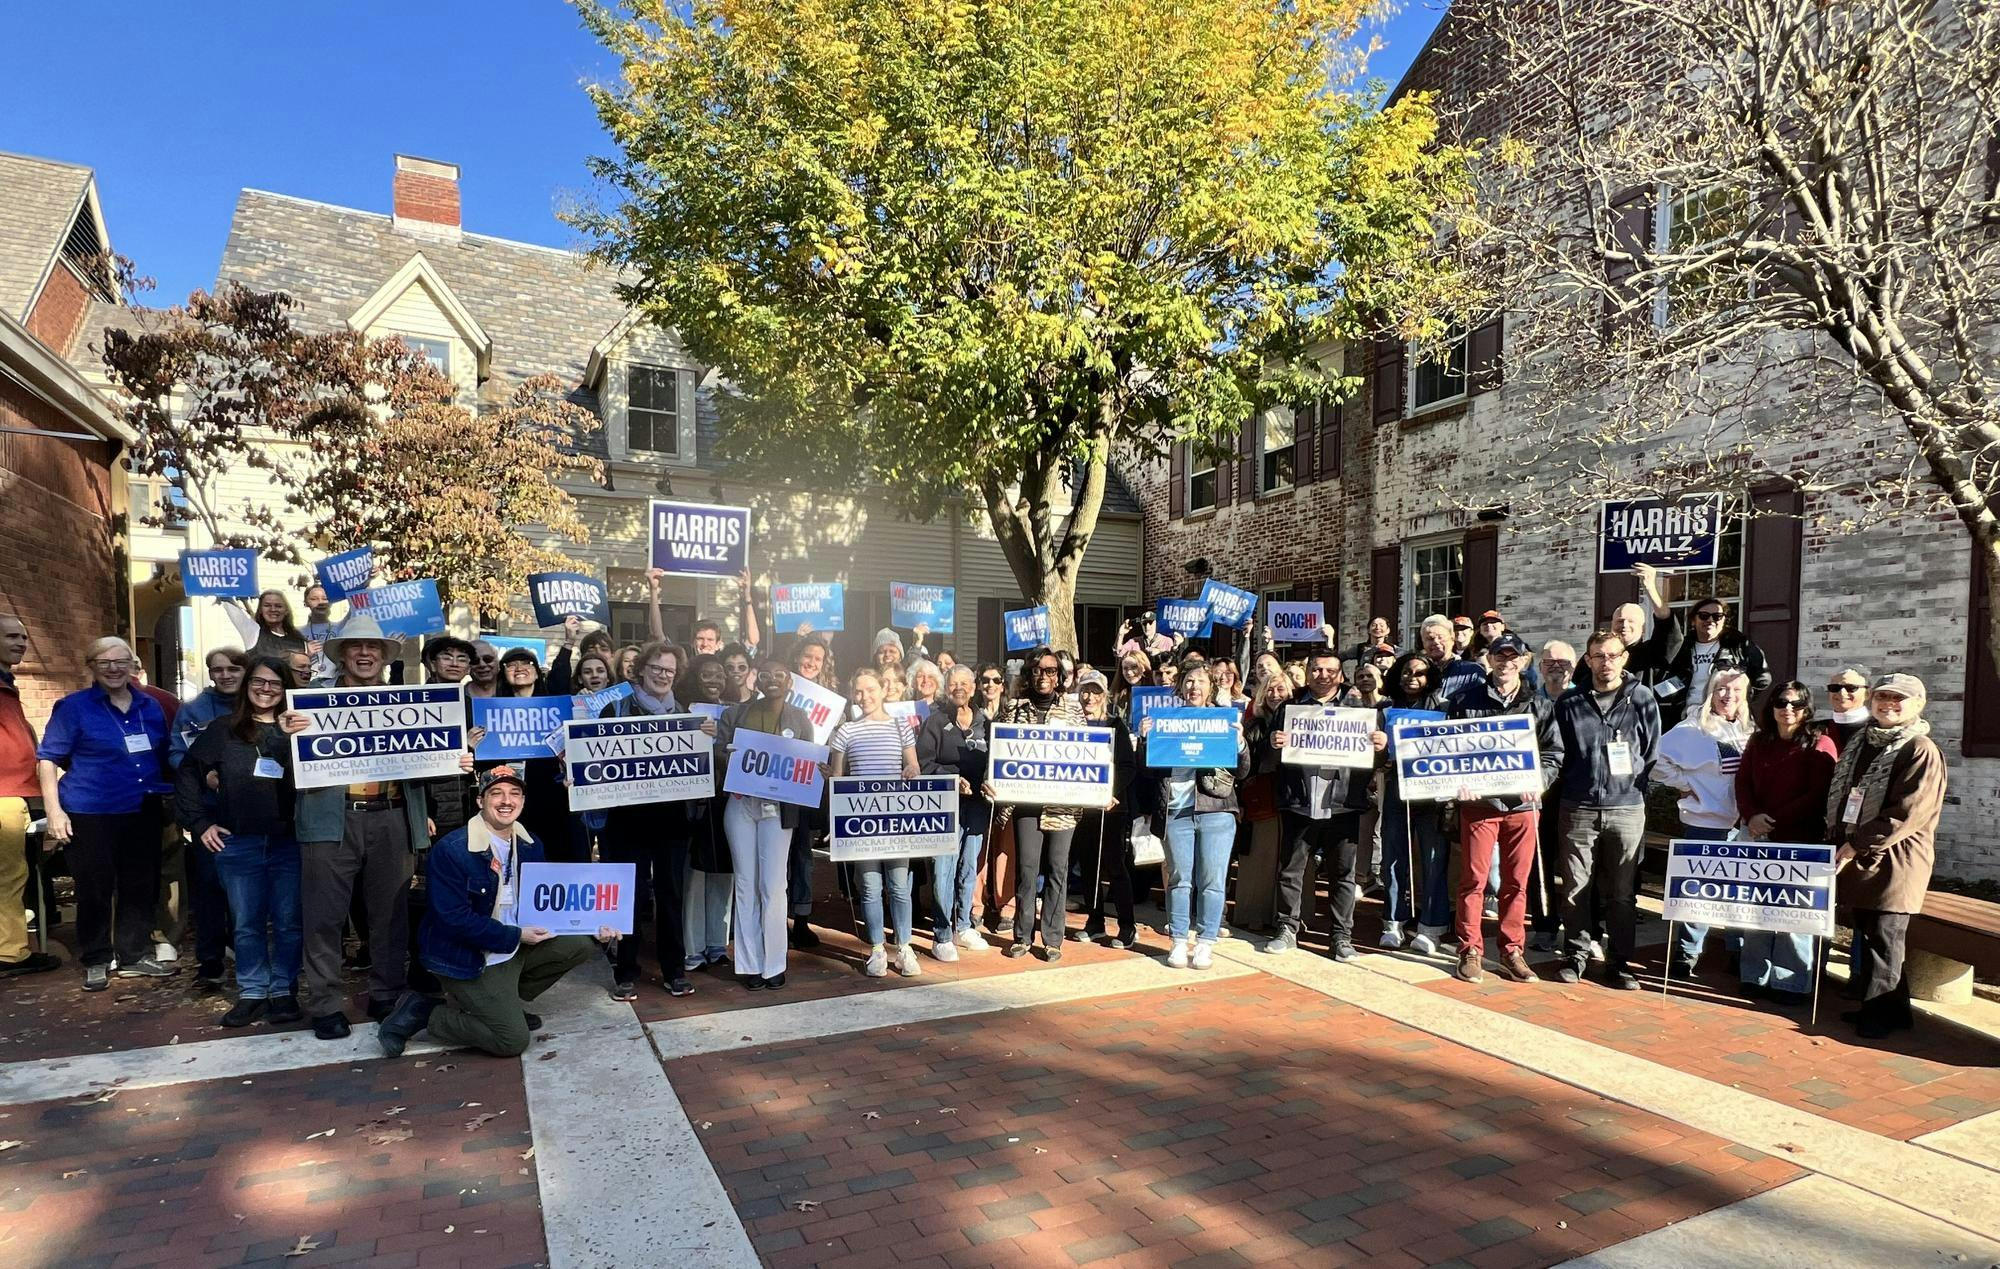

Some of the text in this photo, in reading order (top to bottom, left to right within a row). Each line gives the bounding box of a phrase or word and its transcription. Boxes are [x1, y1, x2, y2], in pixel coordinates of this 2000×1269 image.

[659, 512, 740, 545] HARRIS
[1612, 504, 1708, 537] HARRIS
[671, 542, 728, 560] WALZ
[1625, 536, 1693, 554] WALZ
[188, 556, 248, 576] HARRIS
[326, 552, 373, 583] HARRIS
[198, 577, 240, 588] WALZ
[373, 583, 424, 604] CHOOSE
[538, 580, 600, 605] HARRIS
[792, 585, 832, 600] CHOOSE
[908, 587, 944, 602] CHOOSE
[1206, 587, 1249, 613] HARRIS
[551, 601, 594, 616] WALZ
[776, 600, 824, 614] FREEDOM.
[1163, 605, 1207, 622] HARRIS
[1214, 605, 1238, 620] WALZ
[1169, 621, 1198, 630] WALZ
[1274, 613, 1317, 628] COACH!
[328, 691, 430, 706] BONNIE
[313, 706, 443, 731] WATSON
[486, 707, 562, 732] HARRIS
[598, 720, 683, 736] BONNIE
[1156, 719, 1228, 733] PENNSYLVANIA
[1292, 718, 1368, 734] PENNSYLVANIA
[1018, 729, 1090, 742] BONNIE
[1424, 721, 1505, 736] BONNIE
[312, 731, 449, 757] COLEMAN
[586, 734, 694, 758] WATSON
[1007, 742, 1098, 760] WATSON
[1290, 733, 1366, 752] DEMOCRATS
[1414, 734, 1517, 755] WATSON
[302, 752, 462, 772] DEMOCRAT FOR CONGRESS
[584, 758, 699, 782] COLEMAN
[742, 749, 816, 785] COACH!
[1412, 754, 1524, 776] COLEMAN
[1002, 762, 1100, 782] COLEMAN
[1405, 777, 1458, 786] DEMOCRAT
[1462, 774, 1481, 783] FOR
[576, 777, 710, 796] DEMOCRAT FOR CONGRESS
[858, 781, 932, 792] BONNIE
[848, 794, 942, 812] WATSON
[845, 816, 946, 835] COLEMAN
[837, 839, 886, 848] DEMOCRAT
[908, 835, 954, 844] CONGRESS
[1702, 844, 1798, 860] BONNIE
[1687, 859, 1810, 882] WATSON
[534, 884, 618, 912] COACH!
[1681, 879, 1816, 907] COLEMAN
[1670, 899, 1827, 920] DEMOCRAT FOR CONGRESS
